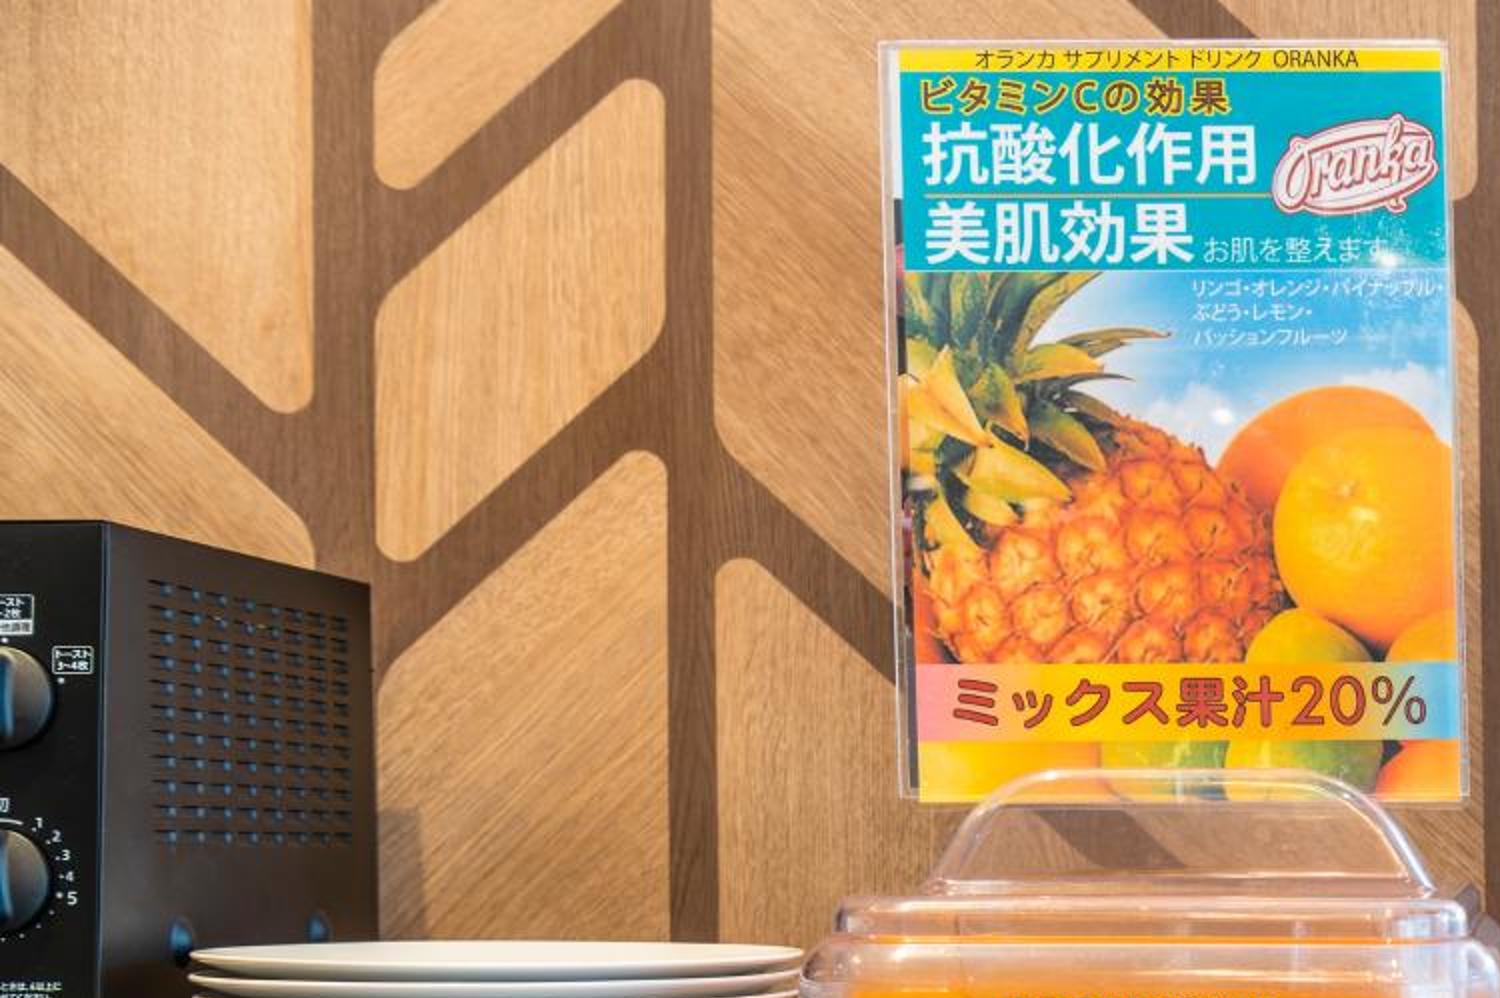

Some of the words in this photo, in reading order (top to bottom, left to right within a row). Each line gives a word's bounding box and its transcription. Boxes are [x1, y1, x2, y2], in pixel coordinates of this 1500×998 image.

[975, 49, 1055, 69] オランカ
[1190, 49, 1262, 69] ドリンク
[1273, 50, 1359, 69] ORANKA
[919, 76, 1232, 116] ビタミンCの効果
[921, 121, 1257, 186] 抗酸化作用
[1274, 117, 1438, 211] Oranka
[924, 200, 1195, 264] 美肌効果
[952, 674, 1428, 730] ミックス果汁20%
[35, 817, 43, 829] 1
[51, 829, 62, 843] 2
[61, 849, 71, 861] 3
[65, 871, 75, 883] 4
[66, 891, 78, 905] 5
